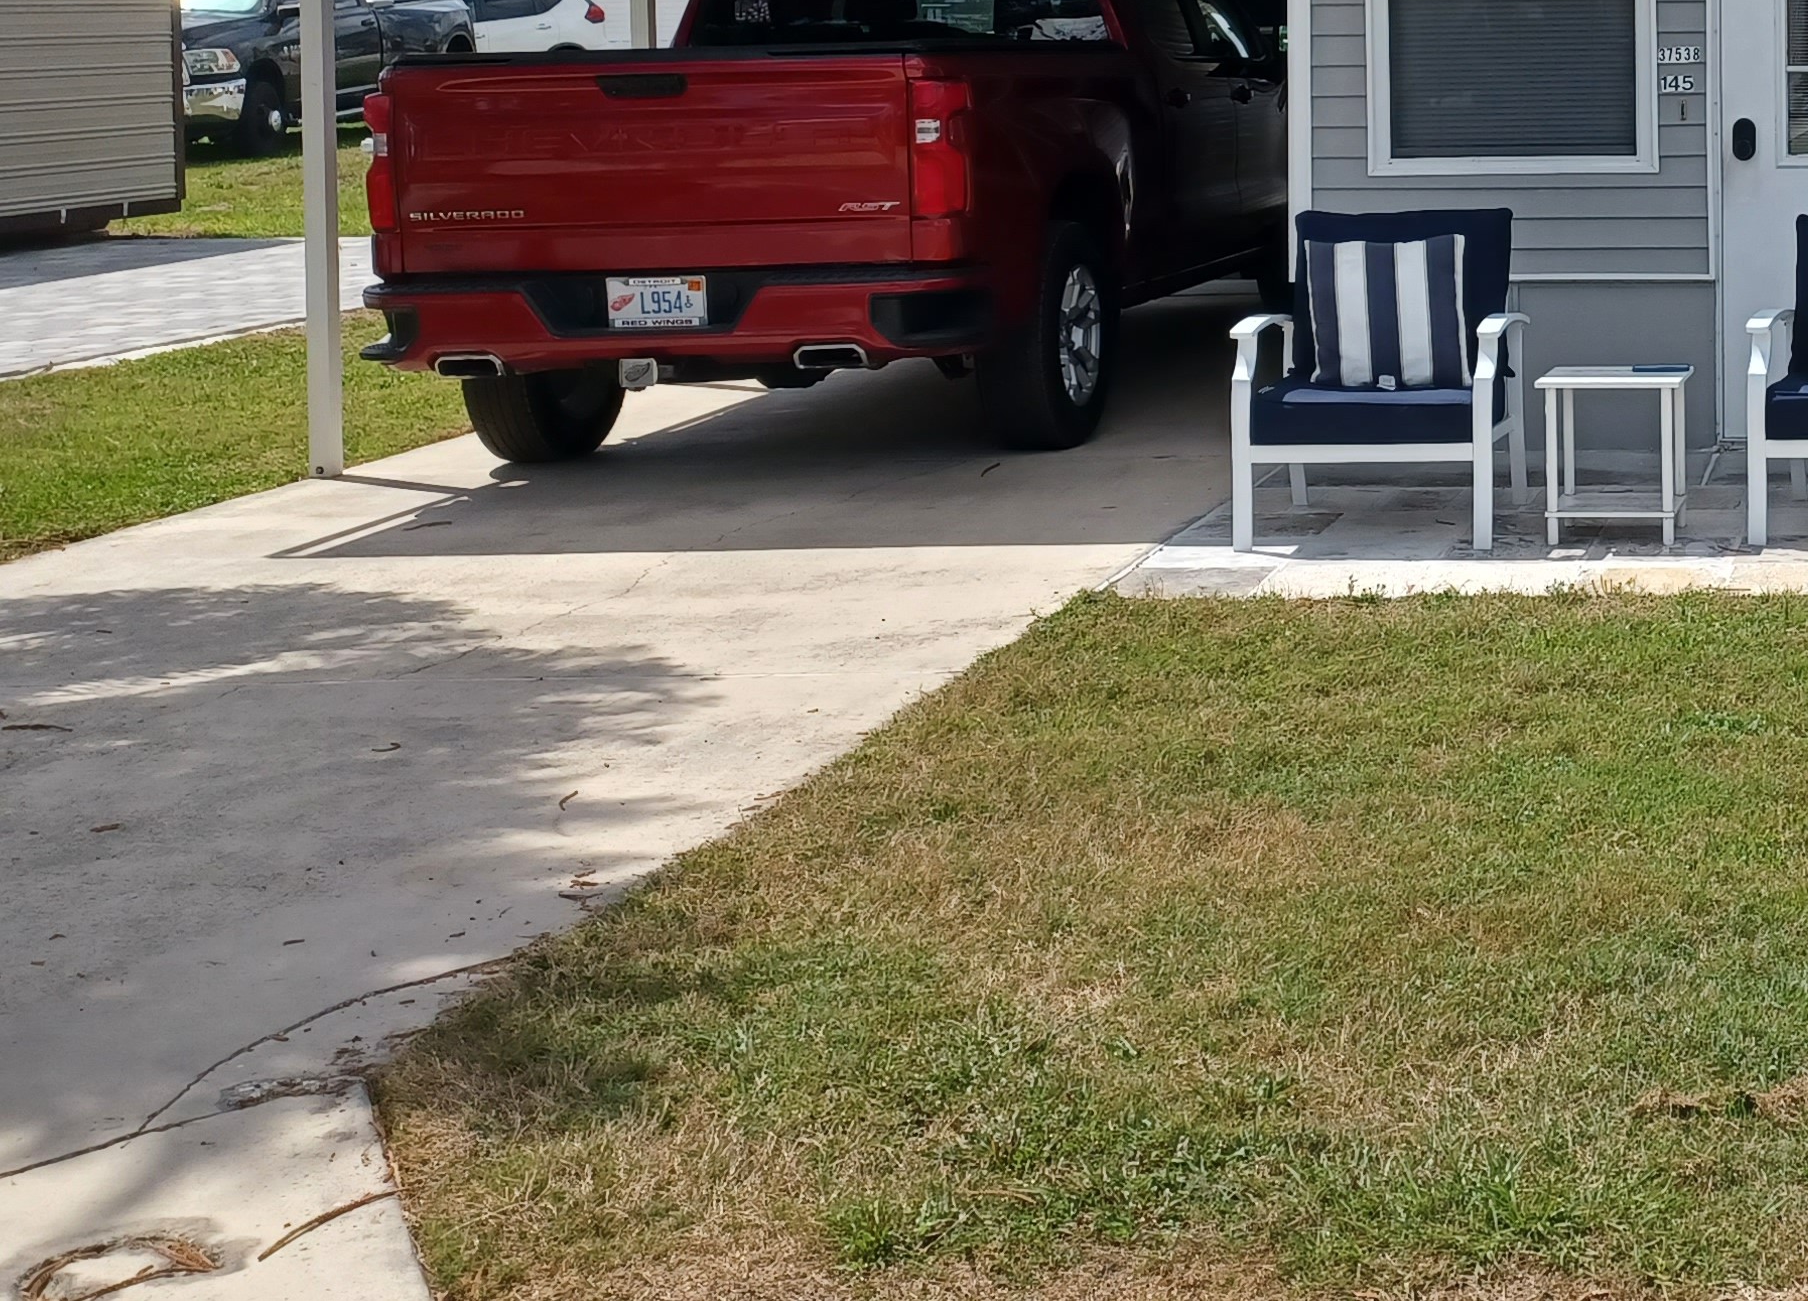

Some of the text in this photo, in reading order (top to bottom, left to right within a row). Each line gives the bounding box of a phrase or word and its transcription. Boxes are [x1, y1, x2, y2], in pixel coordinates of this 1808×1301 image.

[1659, 47, 1700, 61] 37538
[1660, 75, 1694, 91] 145
[409, 210, 525, 221] SILVERADO
[640, 290, 683, 314] L954
